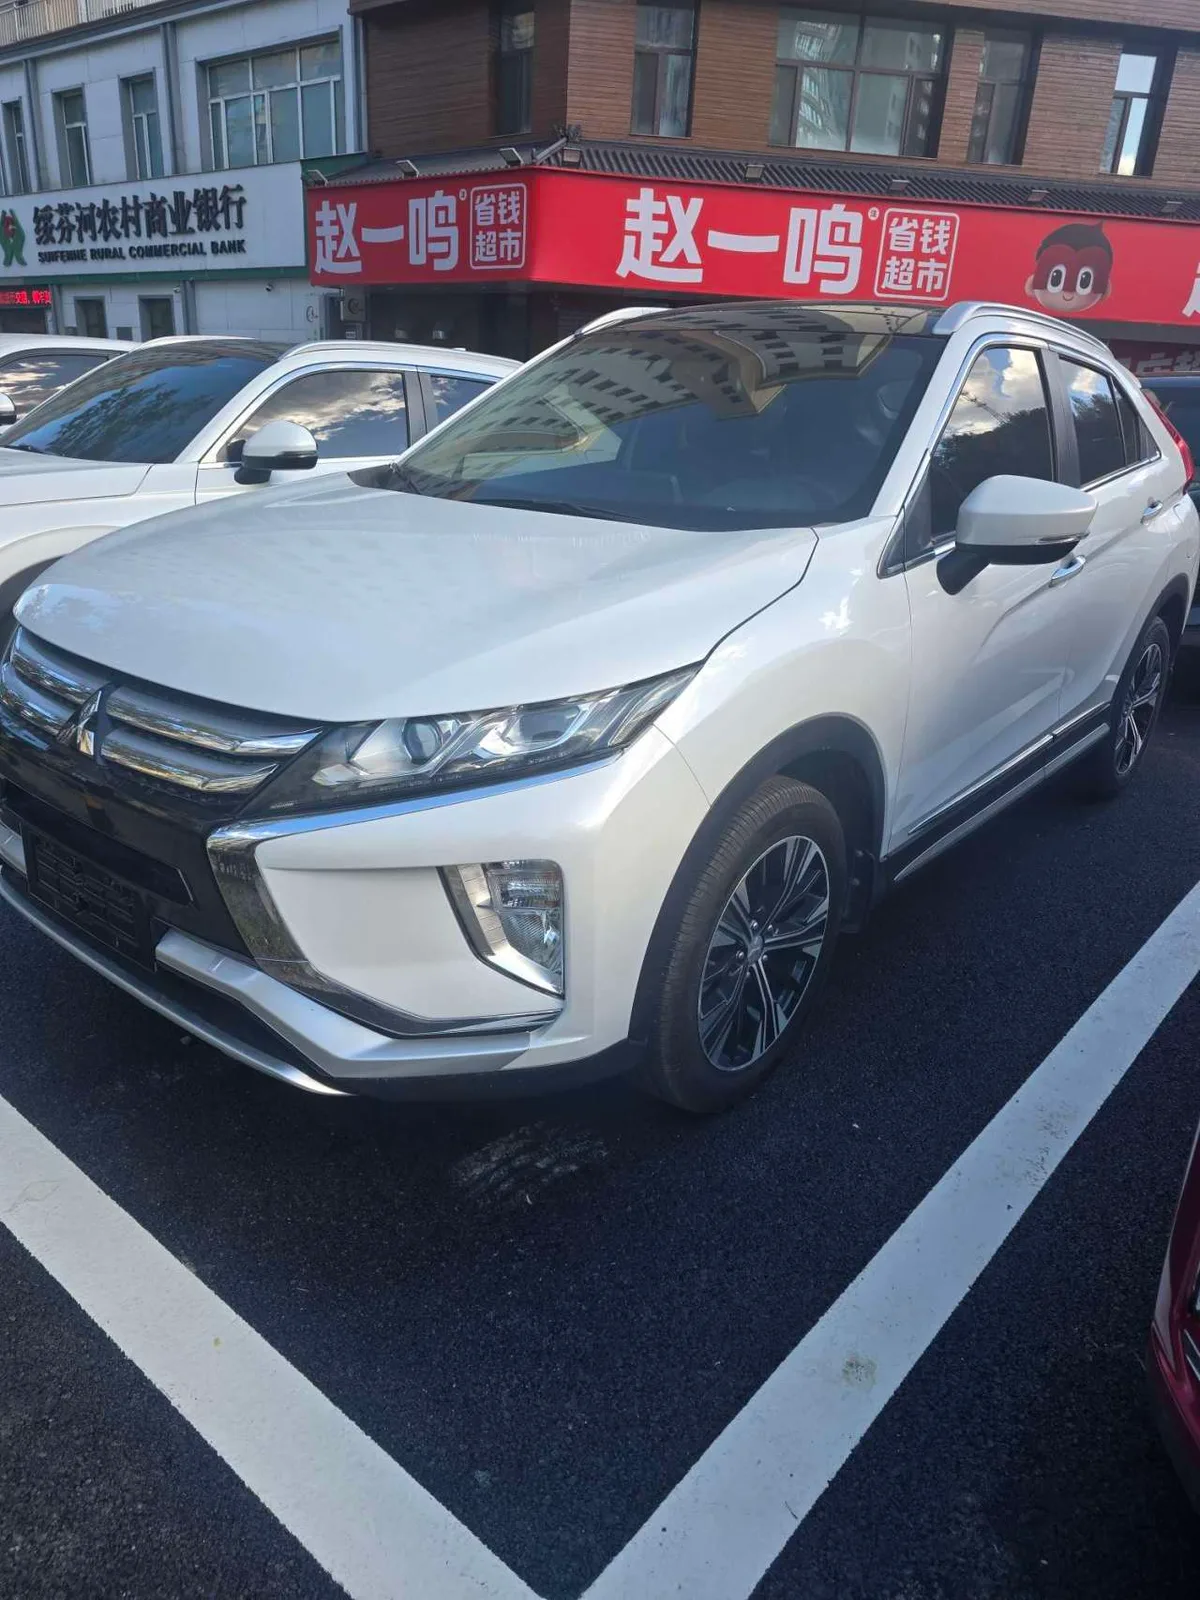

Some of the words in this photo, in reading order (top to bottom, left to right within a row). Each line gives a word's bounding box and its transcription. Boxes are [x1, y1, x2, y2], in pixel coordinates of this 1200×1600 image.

[33, 184, 247, 245] 绥芬河农村商业银行
[475, 191, 520, 225] 省钱
[90, 247, 126, 261] RURAL
[128, 243, 207, 260] COMMERCIAL
[210, 239, 247, 255] BANK
[315, 190, 459, 274] 赵一鸣
[475, 228, 522, 262] 超市
[615, 187, 864, 295] 赵一鸣
[888, 216, 951, 256] 省钱
[883, 256, 948, 293] 超市
